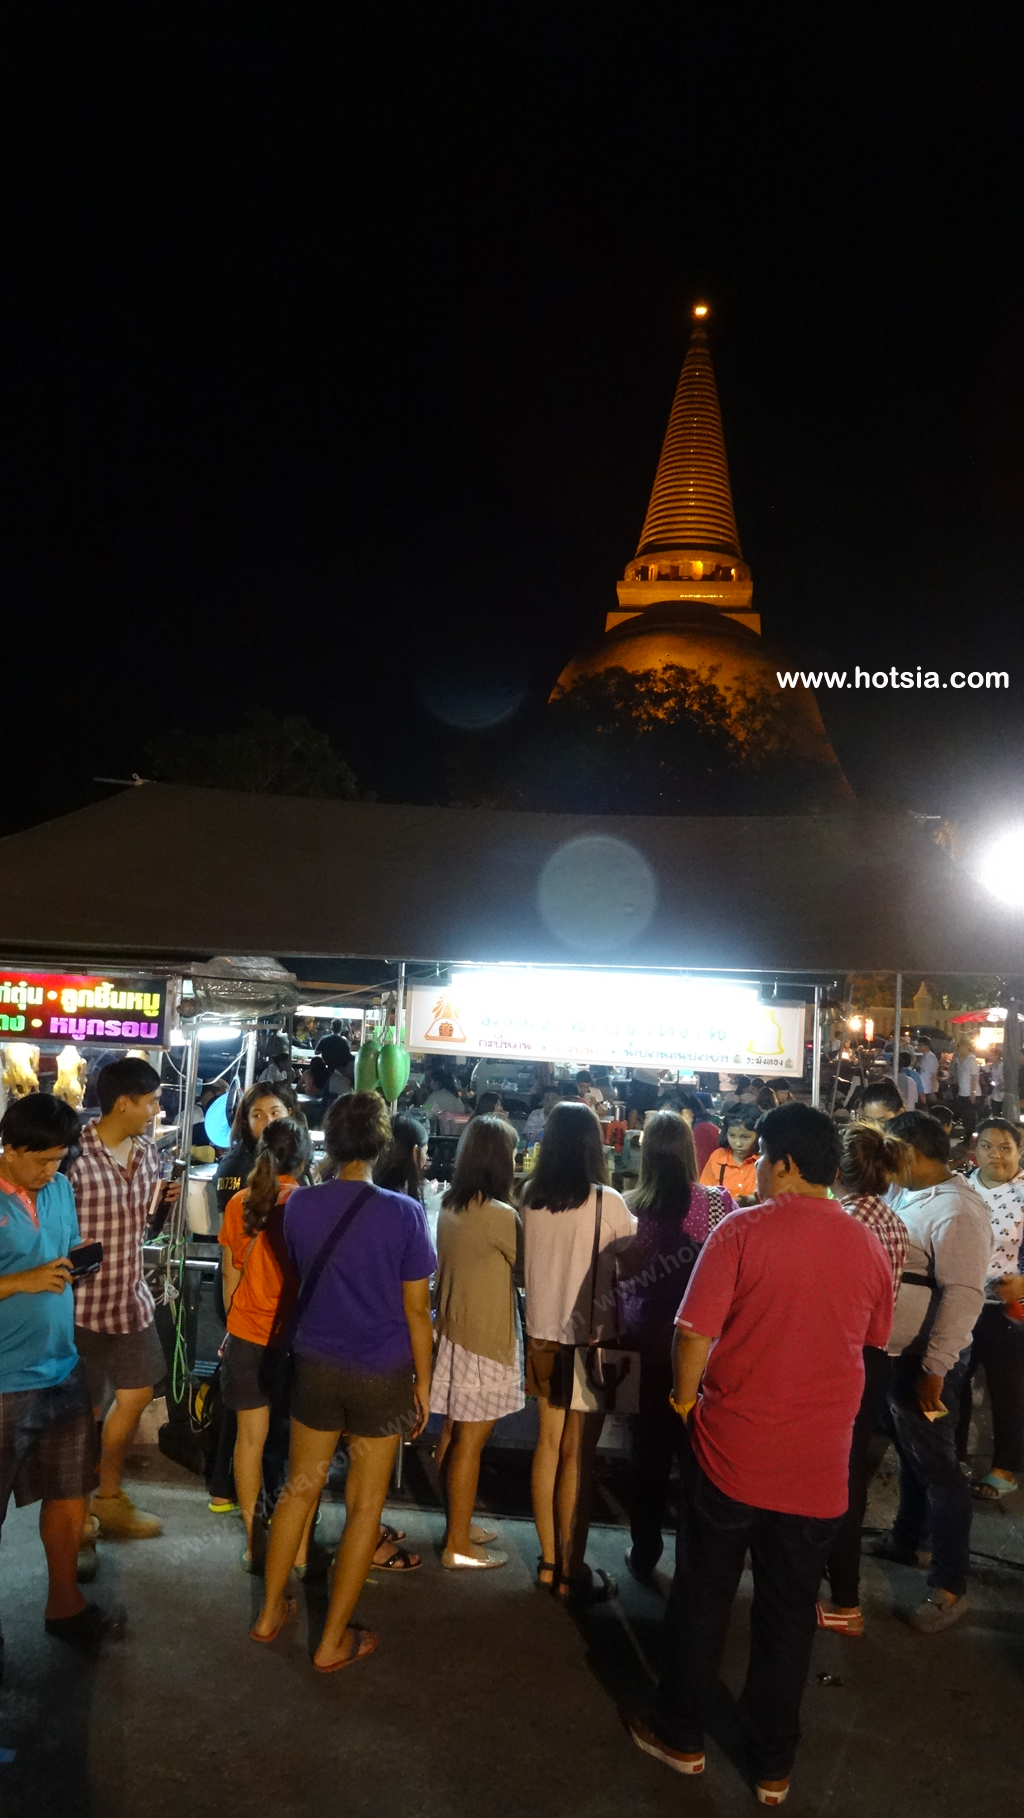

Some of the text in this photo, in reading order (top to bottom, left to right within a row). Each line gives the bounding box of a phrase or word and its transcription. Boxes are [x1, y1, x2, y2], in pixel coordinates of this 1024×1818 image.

[61, 981, 160, 1016] ลูกชิ้นหมู
[50, 1017, 158, 1040] หมูกรอบ
